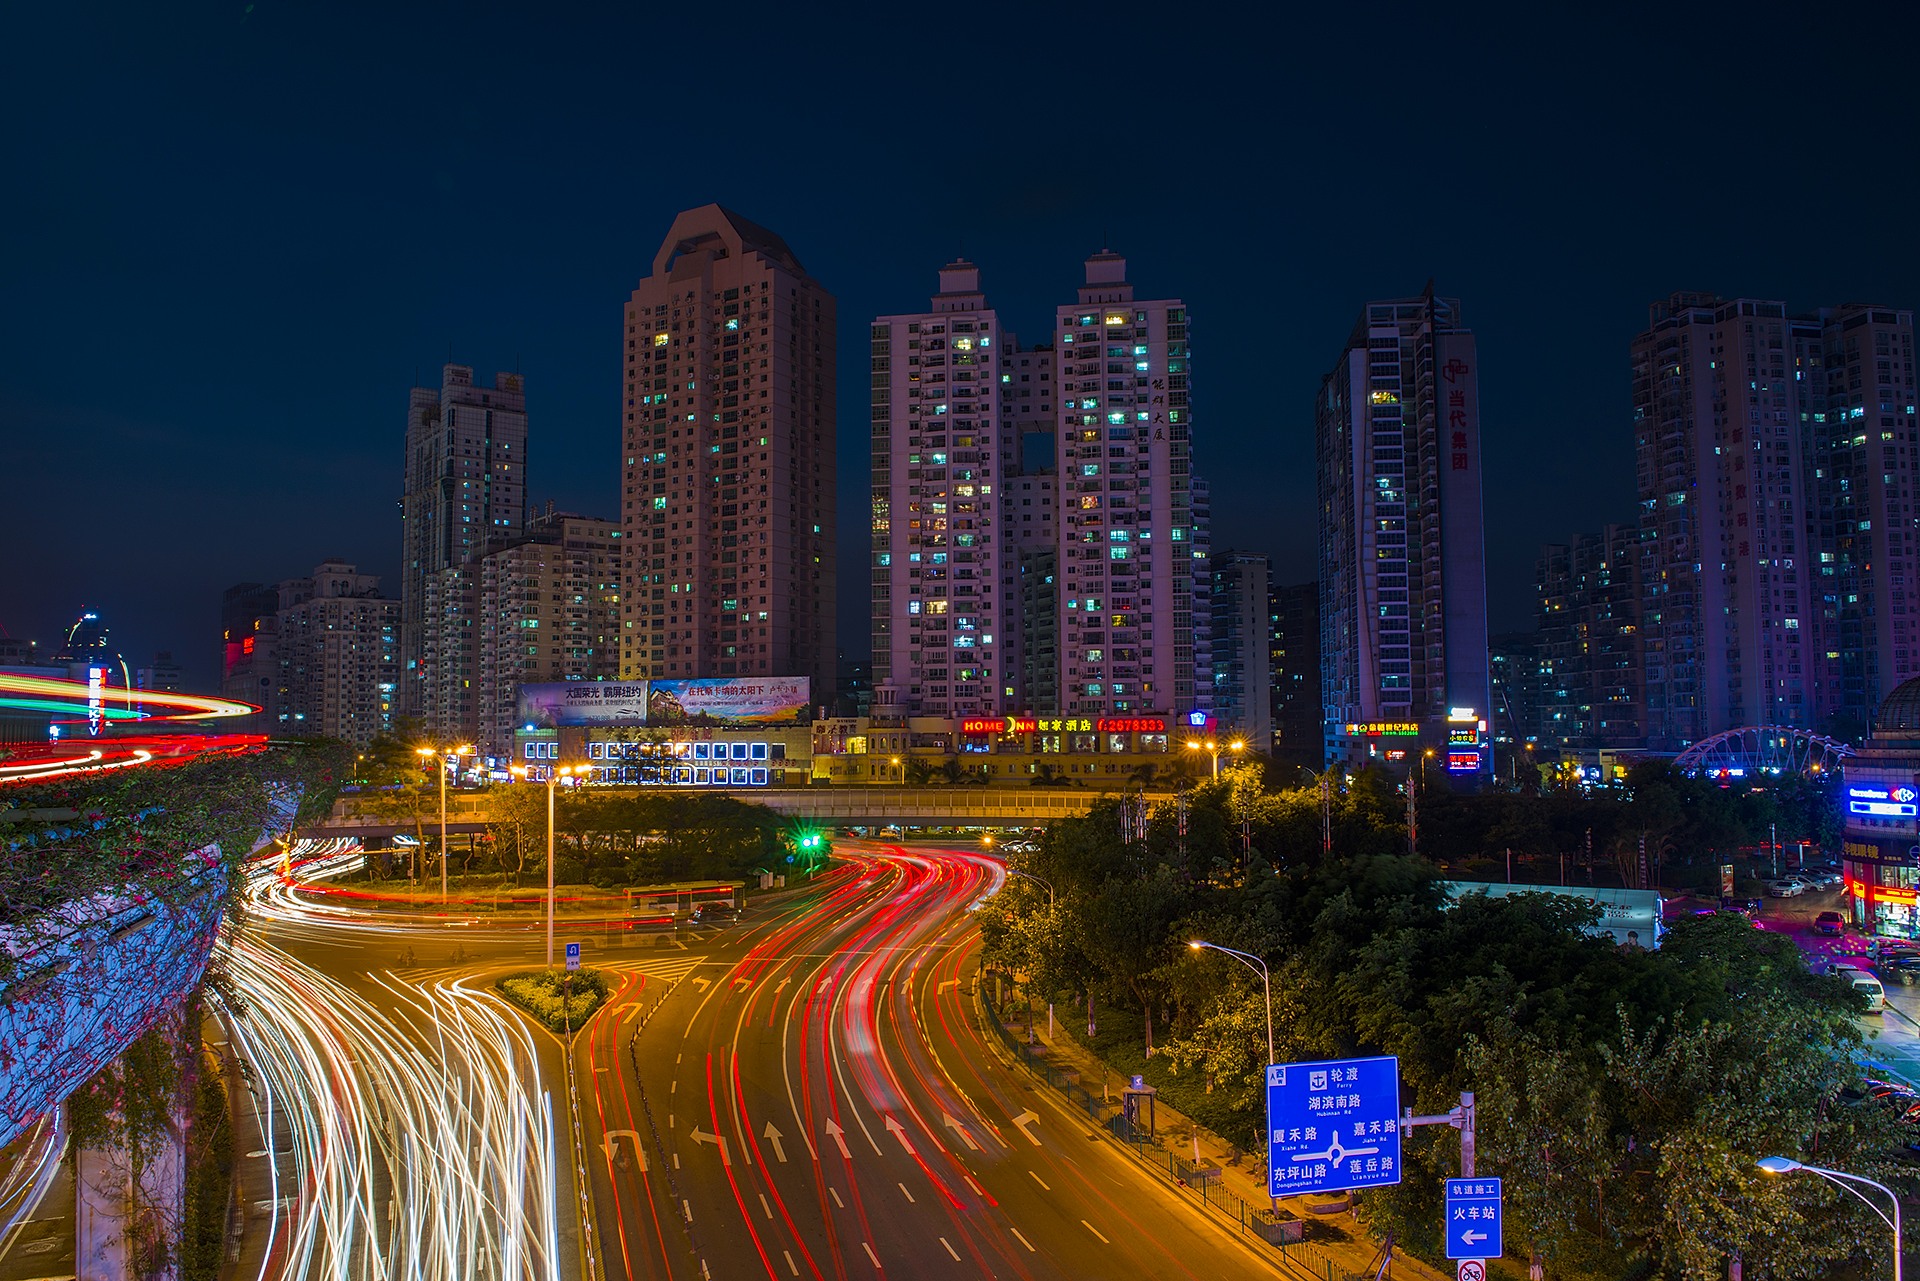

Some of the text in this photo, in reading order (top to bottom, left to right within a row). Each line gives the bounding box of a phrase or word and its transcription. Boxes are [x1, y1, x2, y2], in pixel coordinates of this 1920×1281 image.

[1449, 390, 1468, 471] 当代集团
[566, 686, 641, 699] 大国荣光 霸屏纽约
[688, 685, 765, 697] 在托斯卡纳的太阳下
[964, 721, 1004, 731] HOME
[1038, 719, 1092, 732] 如家酒店
[1331, 1067, 1359, 1082] 轮渡
[1308, 1094, 1361, 1111] 湖滨南路
[1273, 1126, 1317, 1144] 厦禾路
[1353, 1119, 1397, 1137] 嘉禾路
[1349, 1156, 1394, 1174] 莲岳路
[1274, 1164, 1327, 1182] 东坪山路
[1276, 1180, 1313, 1189] Dongpingshan
[1453, 1184, 1495, 1195] 轨道施工
[1453, 1206, 1496, 1220] 火车站
